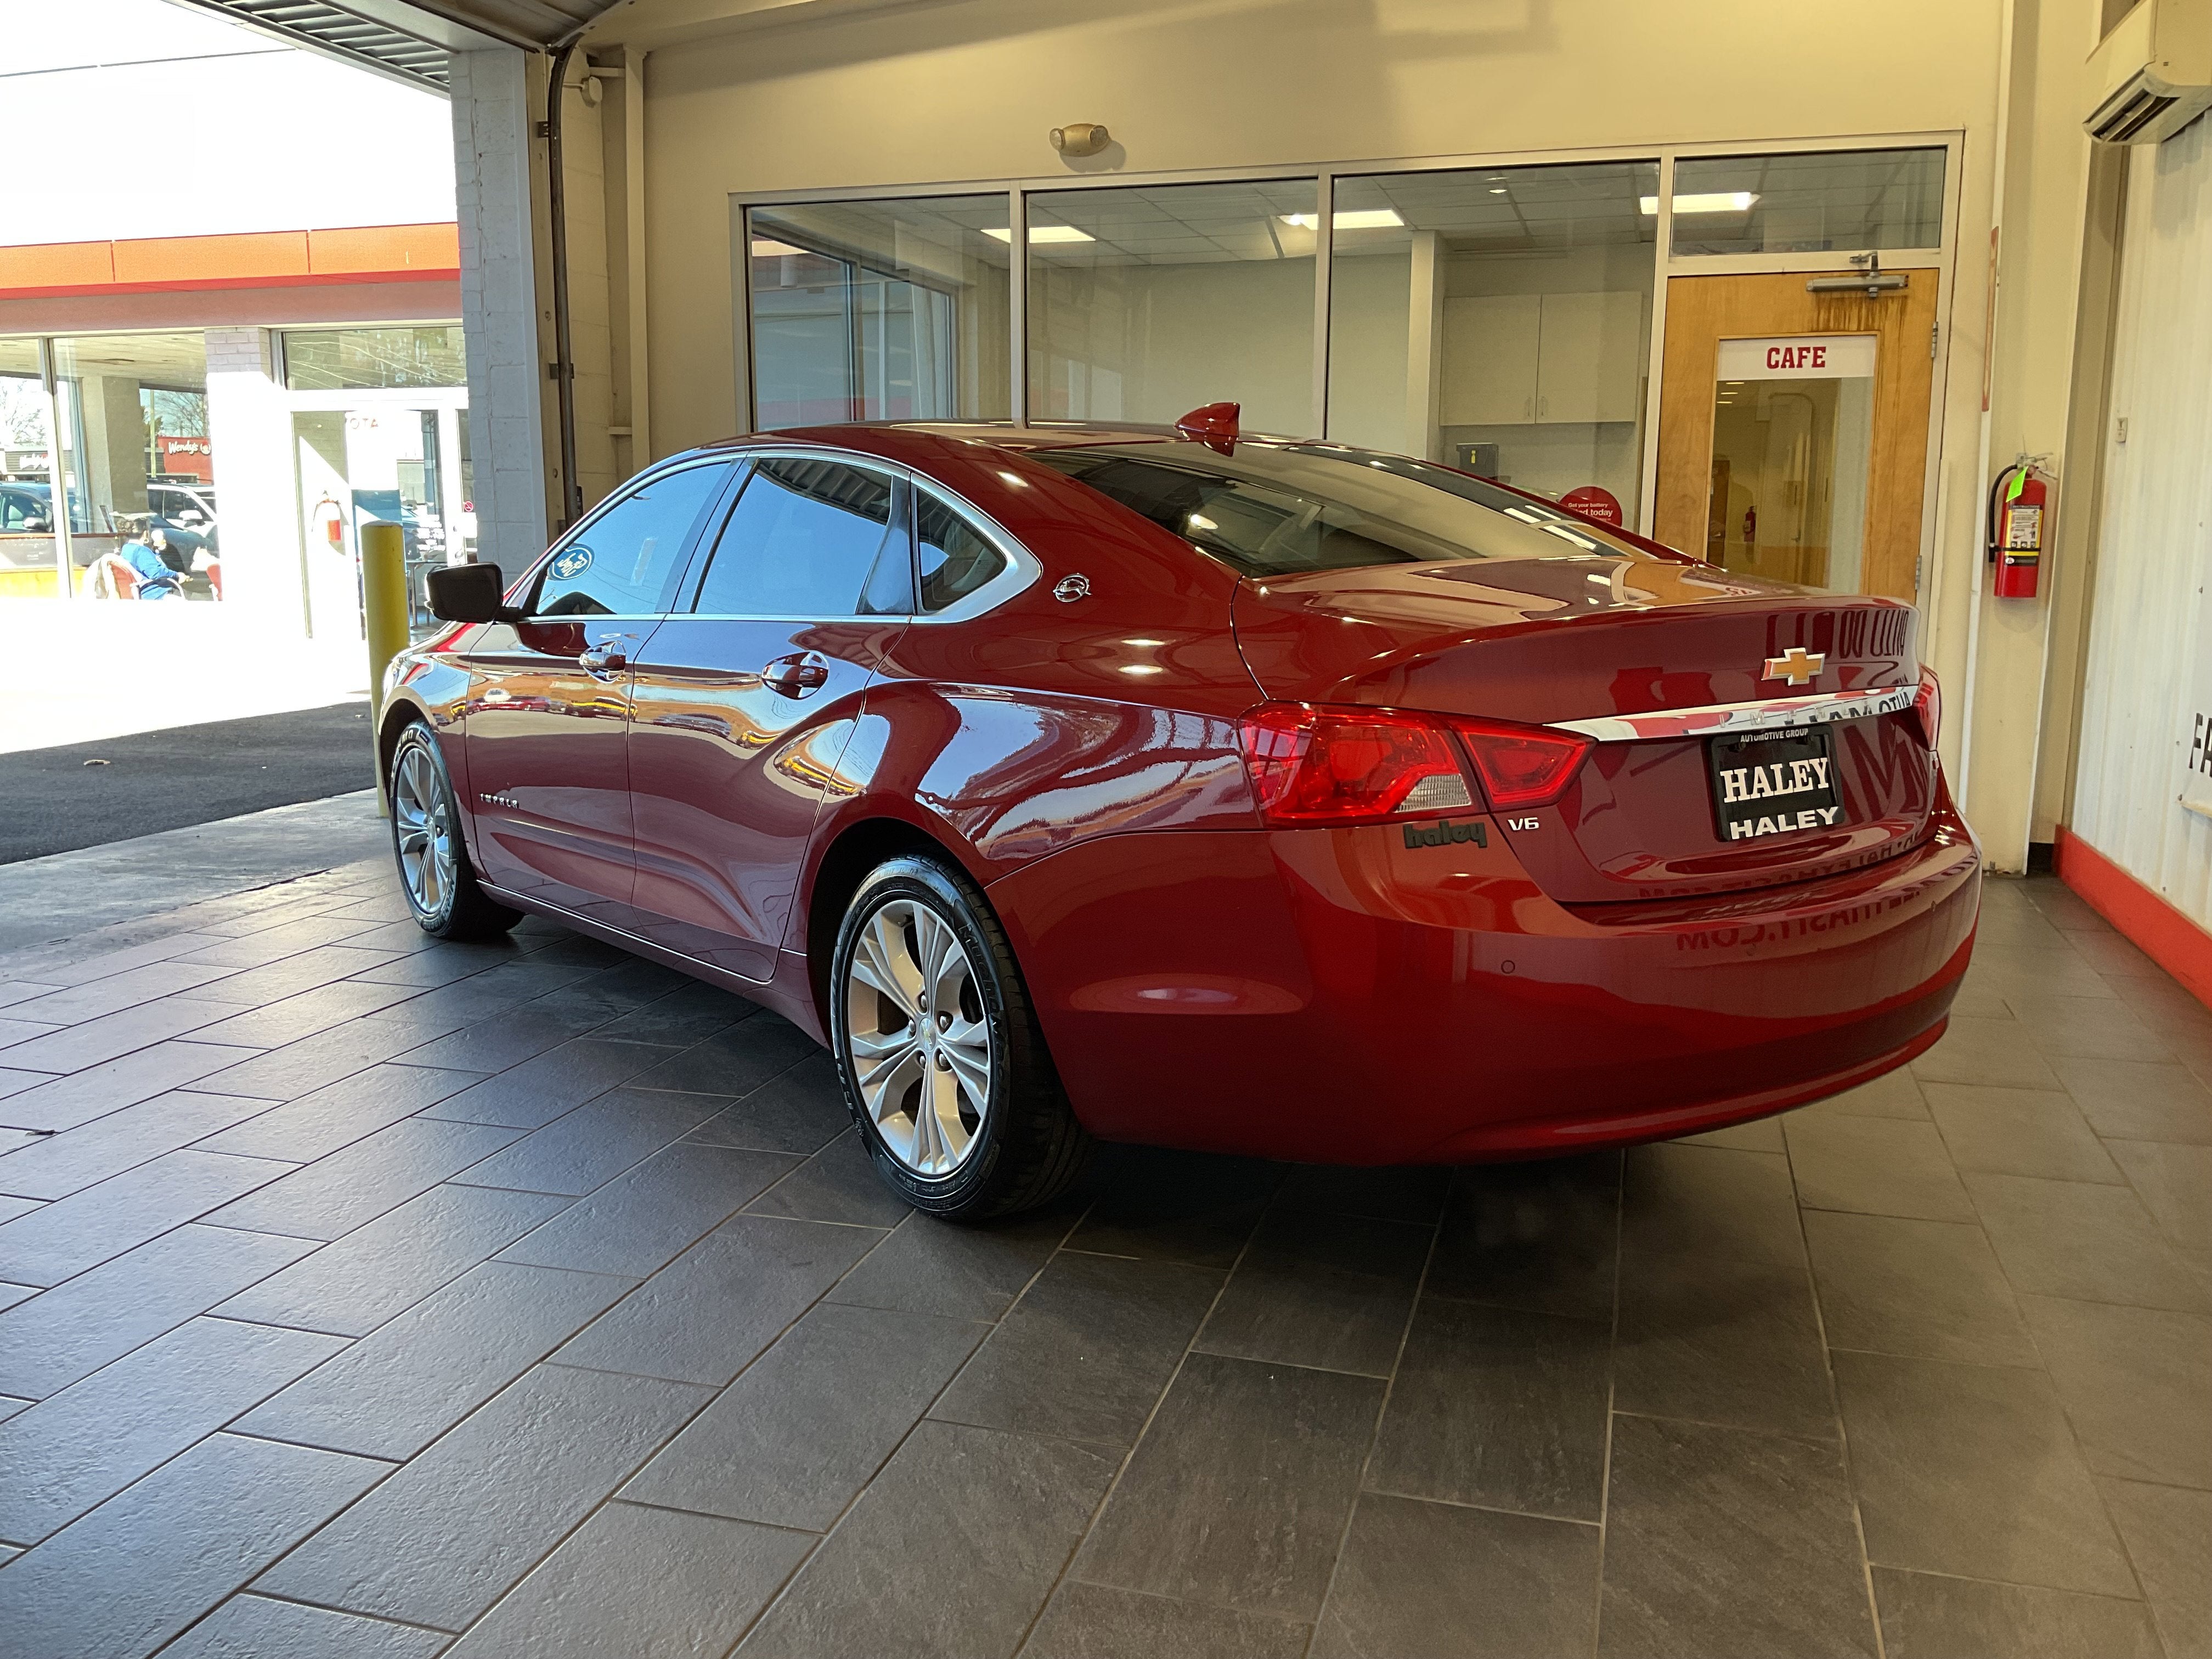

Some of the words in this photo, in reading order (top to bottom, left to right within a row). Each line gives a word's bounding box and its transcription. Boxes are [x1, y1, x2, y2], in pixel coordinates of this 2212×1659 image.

[1767, 346, 1826, 369] CAFE
[168, 440, 198, 454] Wendy's
[1590, 509, 1613, 517] today
[1740, 731, 1784, 743] AUTOMOTIVE
[1785, 727, 1809, 738] GROUP
[1719, 757, 1829, 803] HALEY
[1507, 817, 1540, 831] V6
[1730, 806, 1838, 840] HALEY
[1403, 820, 1488, 849] haley
